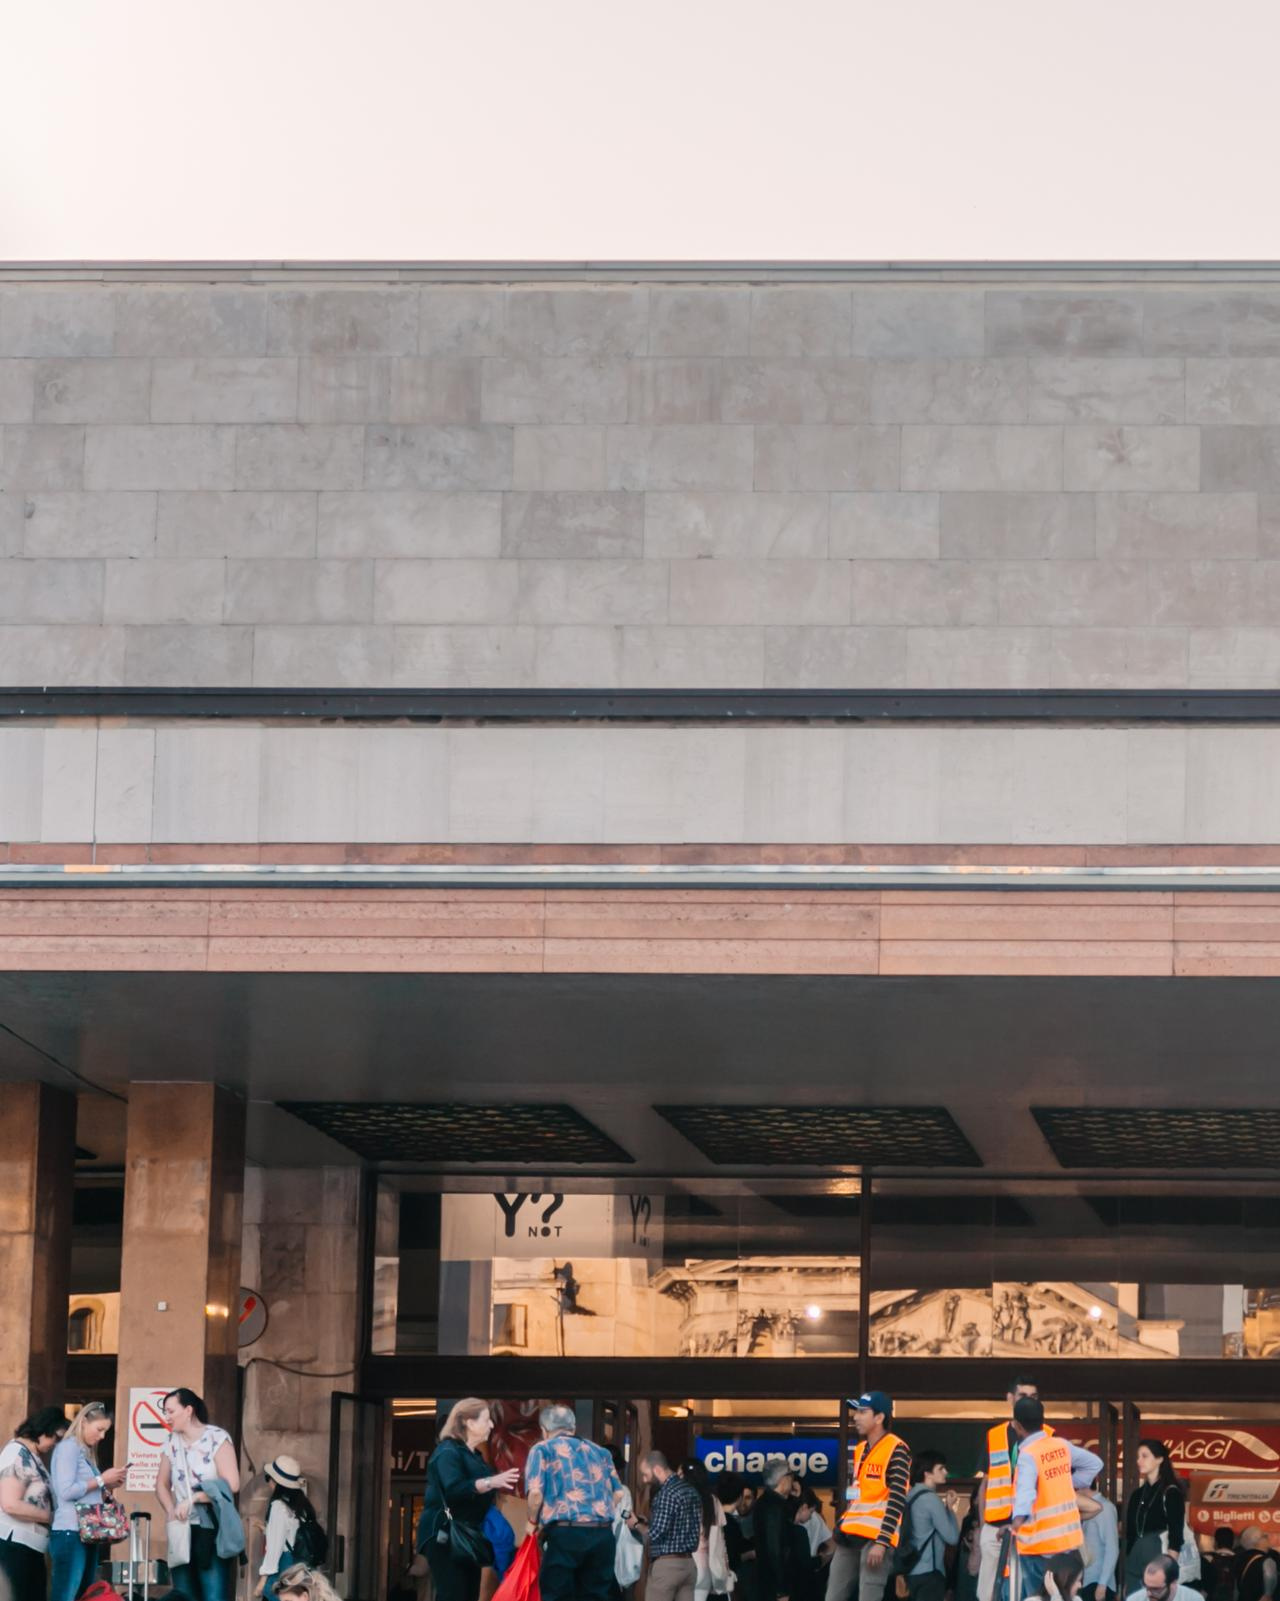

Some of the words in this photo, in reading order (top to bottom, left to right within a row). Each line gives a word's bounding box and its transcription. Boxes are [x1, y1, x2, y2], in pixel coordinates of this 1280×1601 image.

[1041, 1448, 1066, 1464] PORTER
[1164, 1440, 1232, 1459] AGGI
[867, 1463, 882, 1474] TAXI
[1044, 1463, 1070, 1480] SERVIC
[1213, 1511, 1255, 1522] Biglietti
